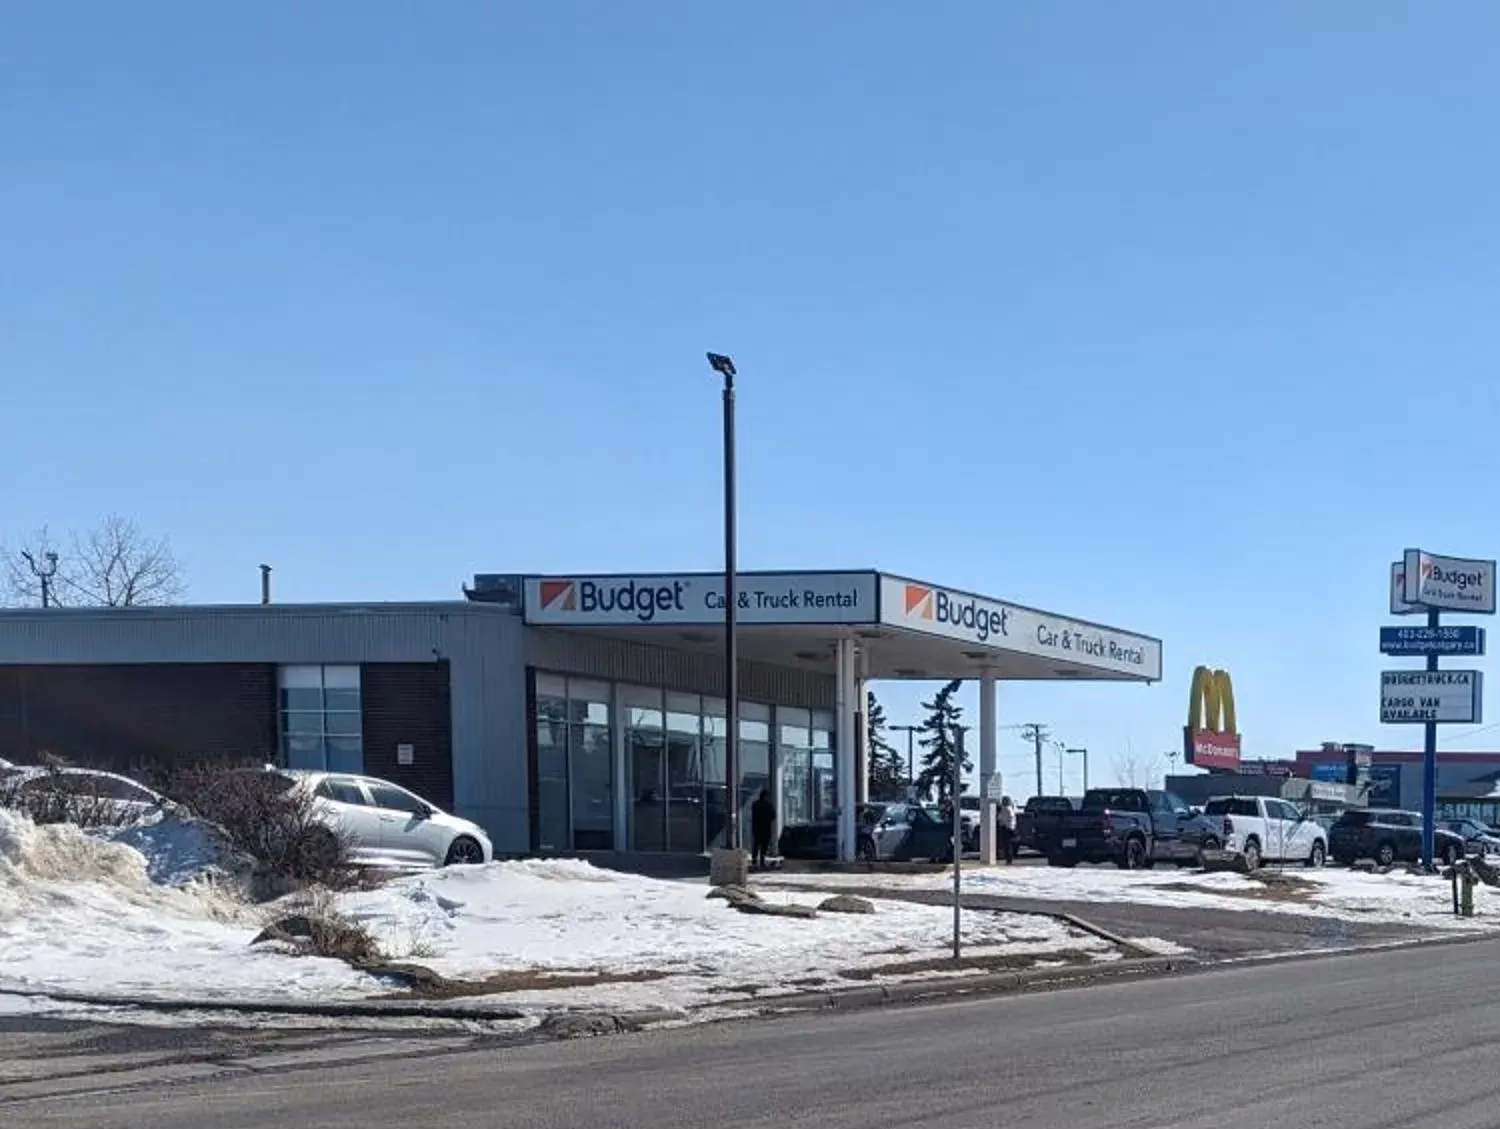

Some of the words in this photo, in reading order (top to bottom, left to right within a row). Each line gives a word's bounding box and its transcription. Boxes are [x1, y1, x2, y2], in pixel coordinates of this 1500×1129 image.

[1433, 565, 1482, 590] Budget
[580, 581, 684, 621] Budget
[704, 591, 727, 609] Ca
[737, 591, 750, 609] &
[754, 591, 799, 609] Truck
[804, 589, 858, 608] Rental
[936, 591, 1008, 641] Budget
[1037, 624, 1059, 648] Car
[1062, 629, 1072, 650] &
[1074, 632, 1105, 657] Truck
[1109, 640, 1145, 665] Rental
[1420, 696, 1440, 708] VAN
